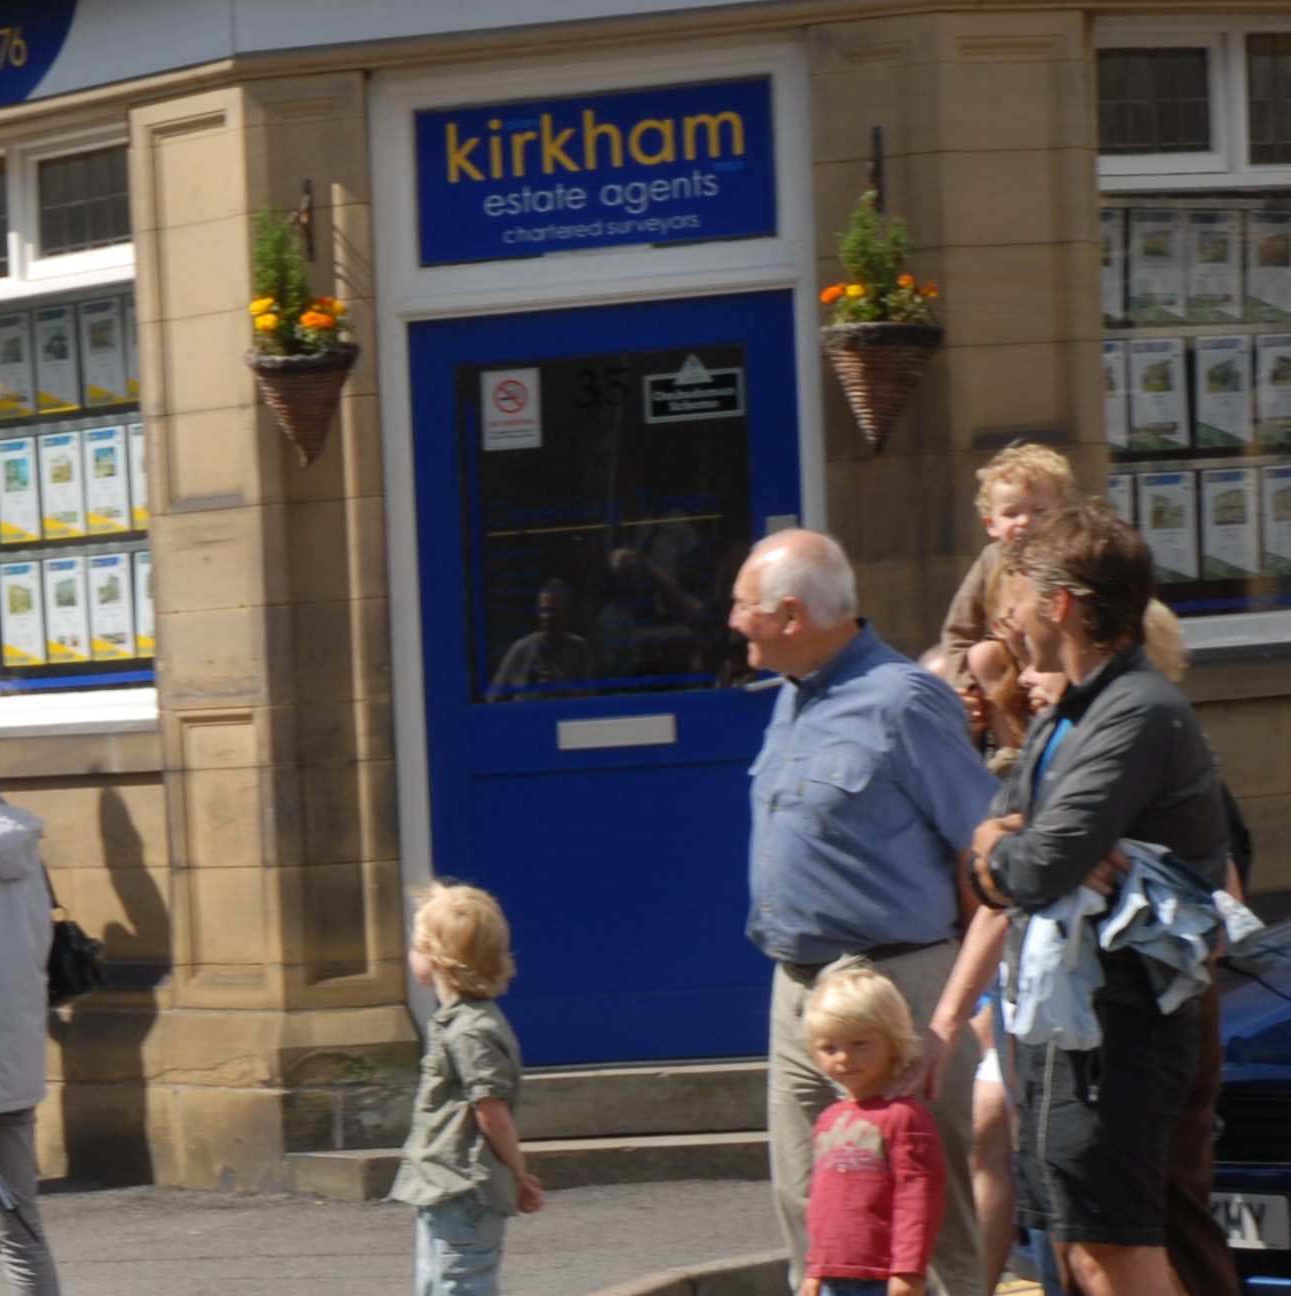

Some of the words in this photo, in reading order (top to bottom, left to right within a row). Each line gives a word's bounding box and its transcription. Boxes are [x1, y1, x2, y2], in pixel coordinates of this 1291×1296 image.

[445, 108, 745, 184] kirkham
[483, 183, 588, 217] estate
[599, 168, 720, 215] agents
[501, 219, 604, 244] chartered
[606, 211, 701, 235] surveyors
